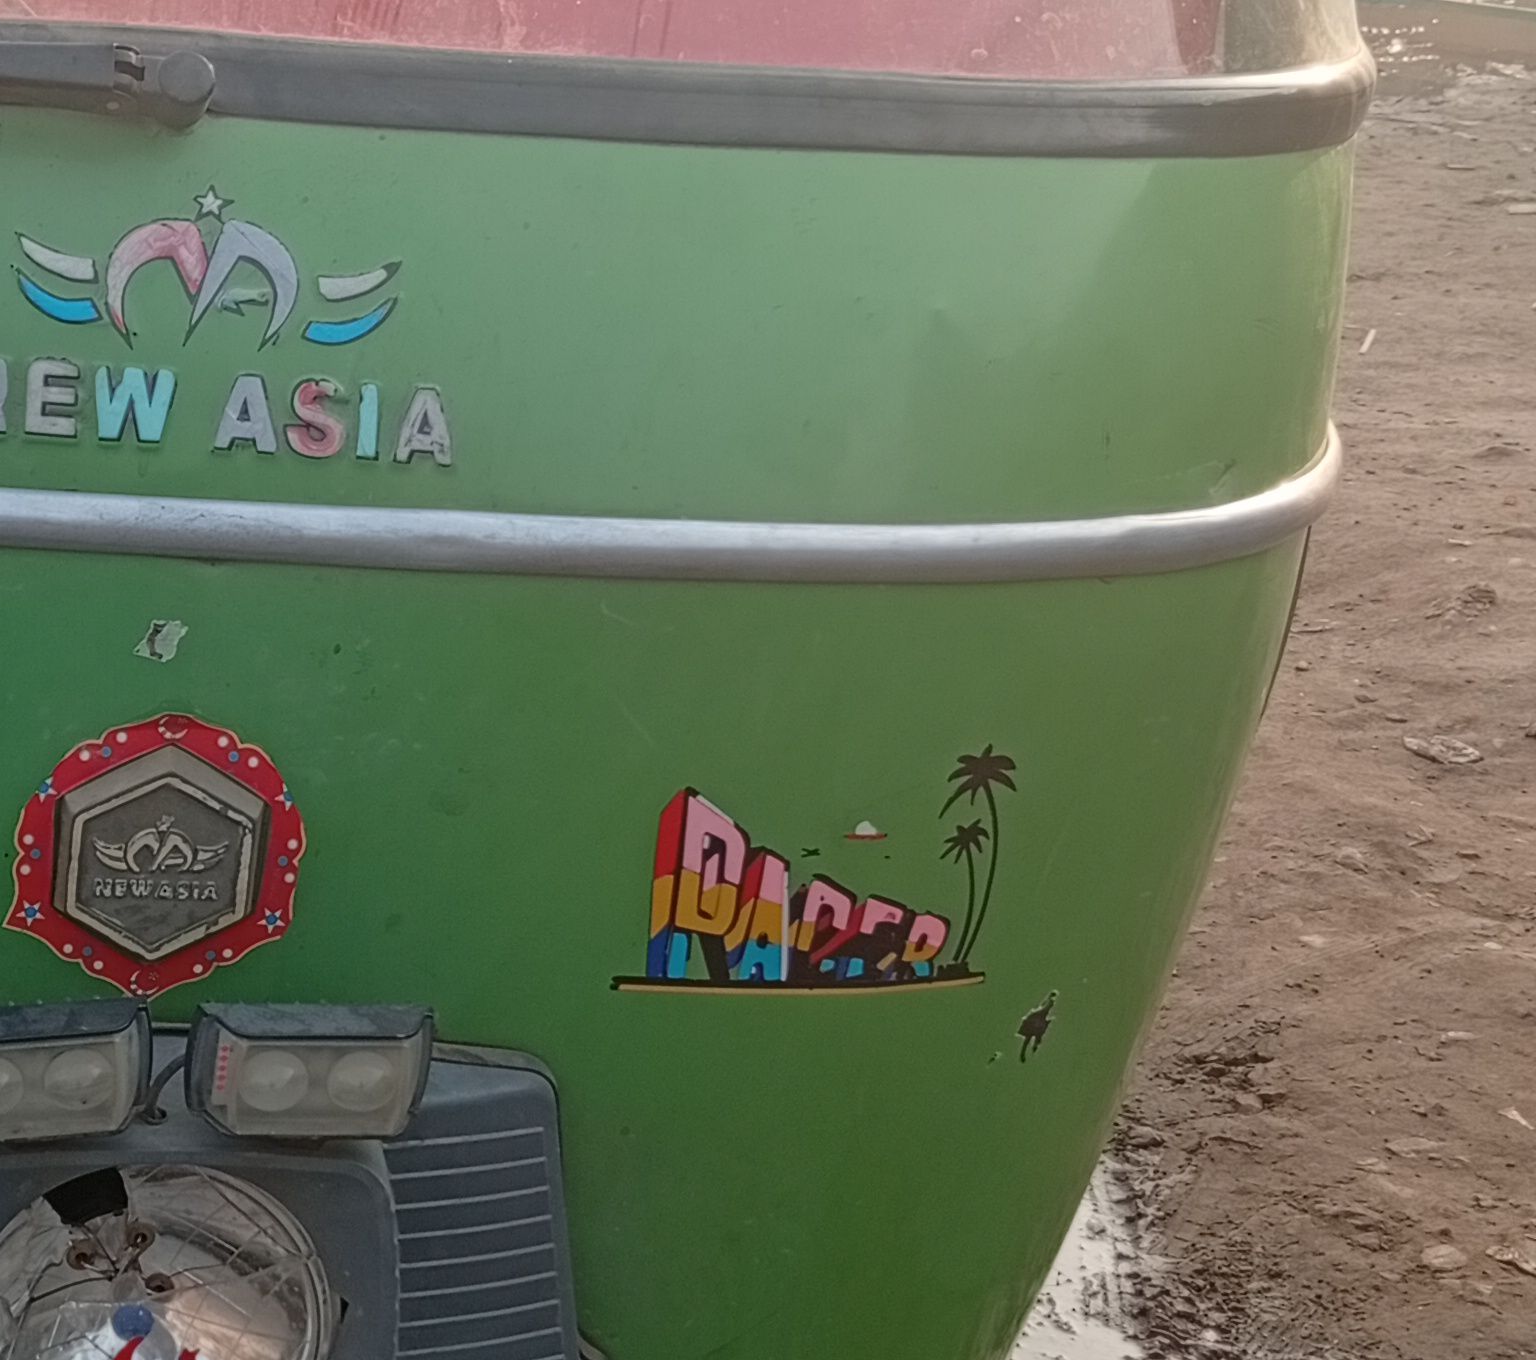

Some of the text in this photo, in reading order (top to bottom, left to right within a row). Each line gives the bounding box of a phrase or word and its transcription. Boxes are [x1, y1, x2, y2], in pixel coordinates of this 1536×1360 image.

[211, 372, 453, 466] ASIA
[93, 877, 219, 901] NEW ASIA
